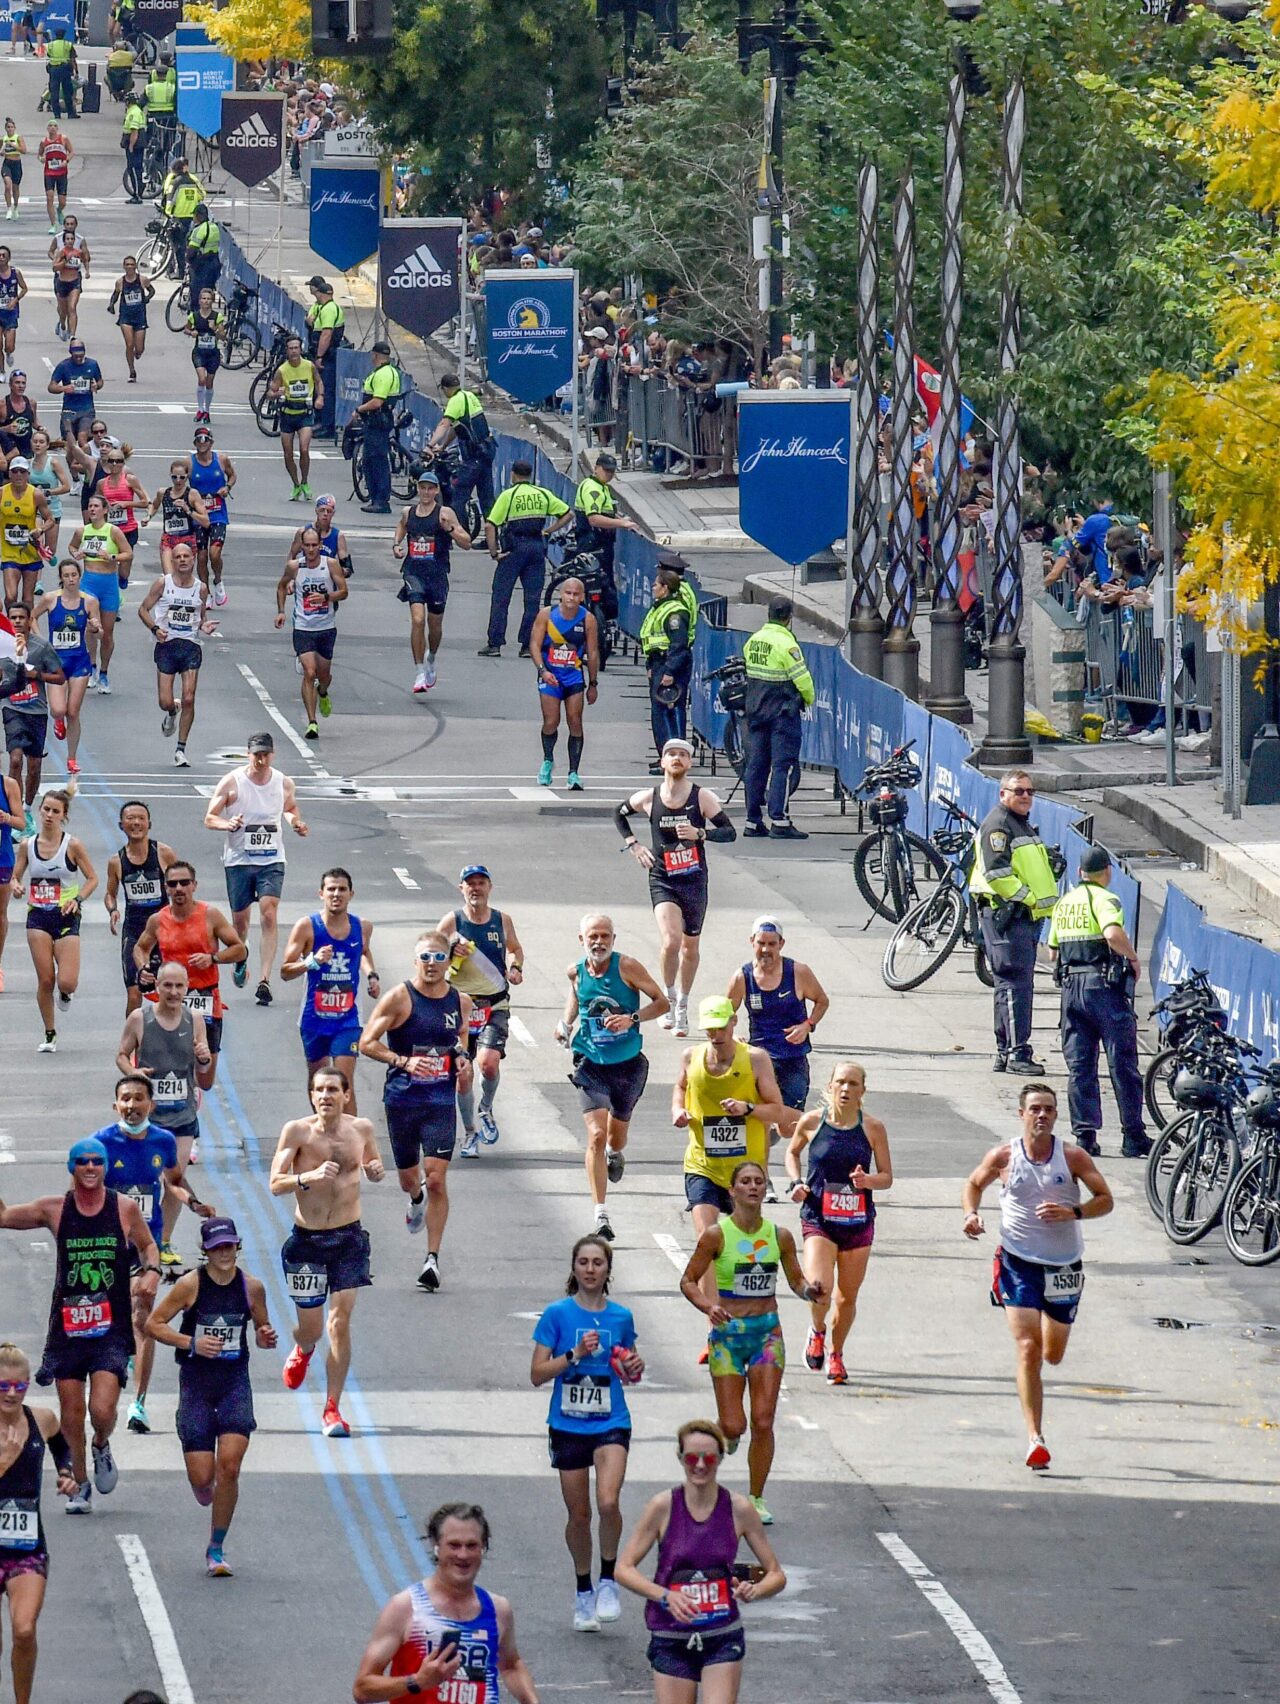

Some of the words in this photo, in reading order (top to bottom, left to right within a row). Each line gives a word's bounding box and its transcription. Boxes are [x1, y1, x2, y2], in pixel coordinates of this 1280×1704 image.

[226, 134, 277, 148] adidas
[387, 271, 452, 289] adidas
[492, 330, 523, 338] BOSTON
[524, 329, 566, 337] MARATHON
[742, 437, 785, 473] John
[783, 436, 848, 465] Hancock
[515, 494, 542, 503] STATE
[515, 500, 544, 512] POLICE
[250, 832, 272, 845] 6972
[130, 882, 155, 896] 5506
[1057, 903, 1088, 917] STATE
[1056, 916, 1090, 931] POLICE
[321, 972, 352, 982] RUNNING
[321, 992, 347, 1009] 2017
[157, 1079, 184, 1095] 6214
[710, 1126, 739, 1143] 4322
[66, 1238, 95, 1249] DADDY
[96, 1236, 118, 1248] MODE
[67, 1251, 74, 1262] IN
[74, 1249, 116, 1262] PROGRESS
[292, 1274, 318, 1291] 6371
[741, 1274, 771, 1290] 4622
[1052, 1273, 1081, 1289] 4530
[70, 1305, 103, 1325] 3479
[569, 1386, 602, 1404] 6174
[437, 1682, 478, 1704] 3160
